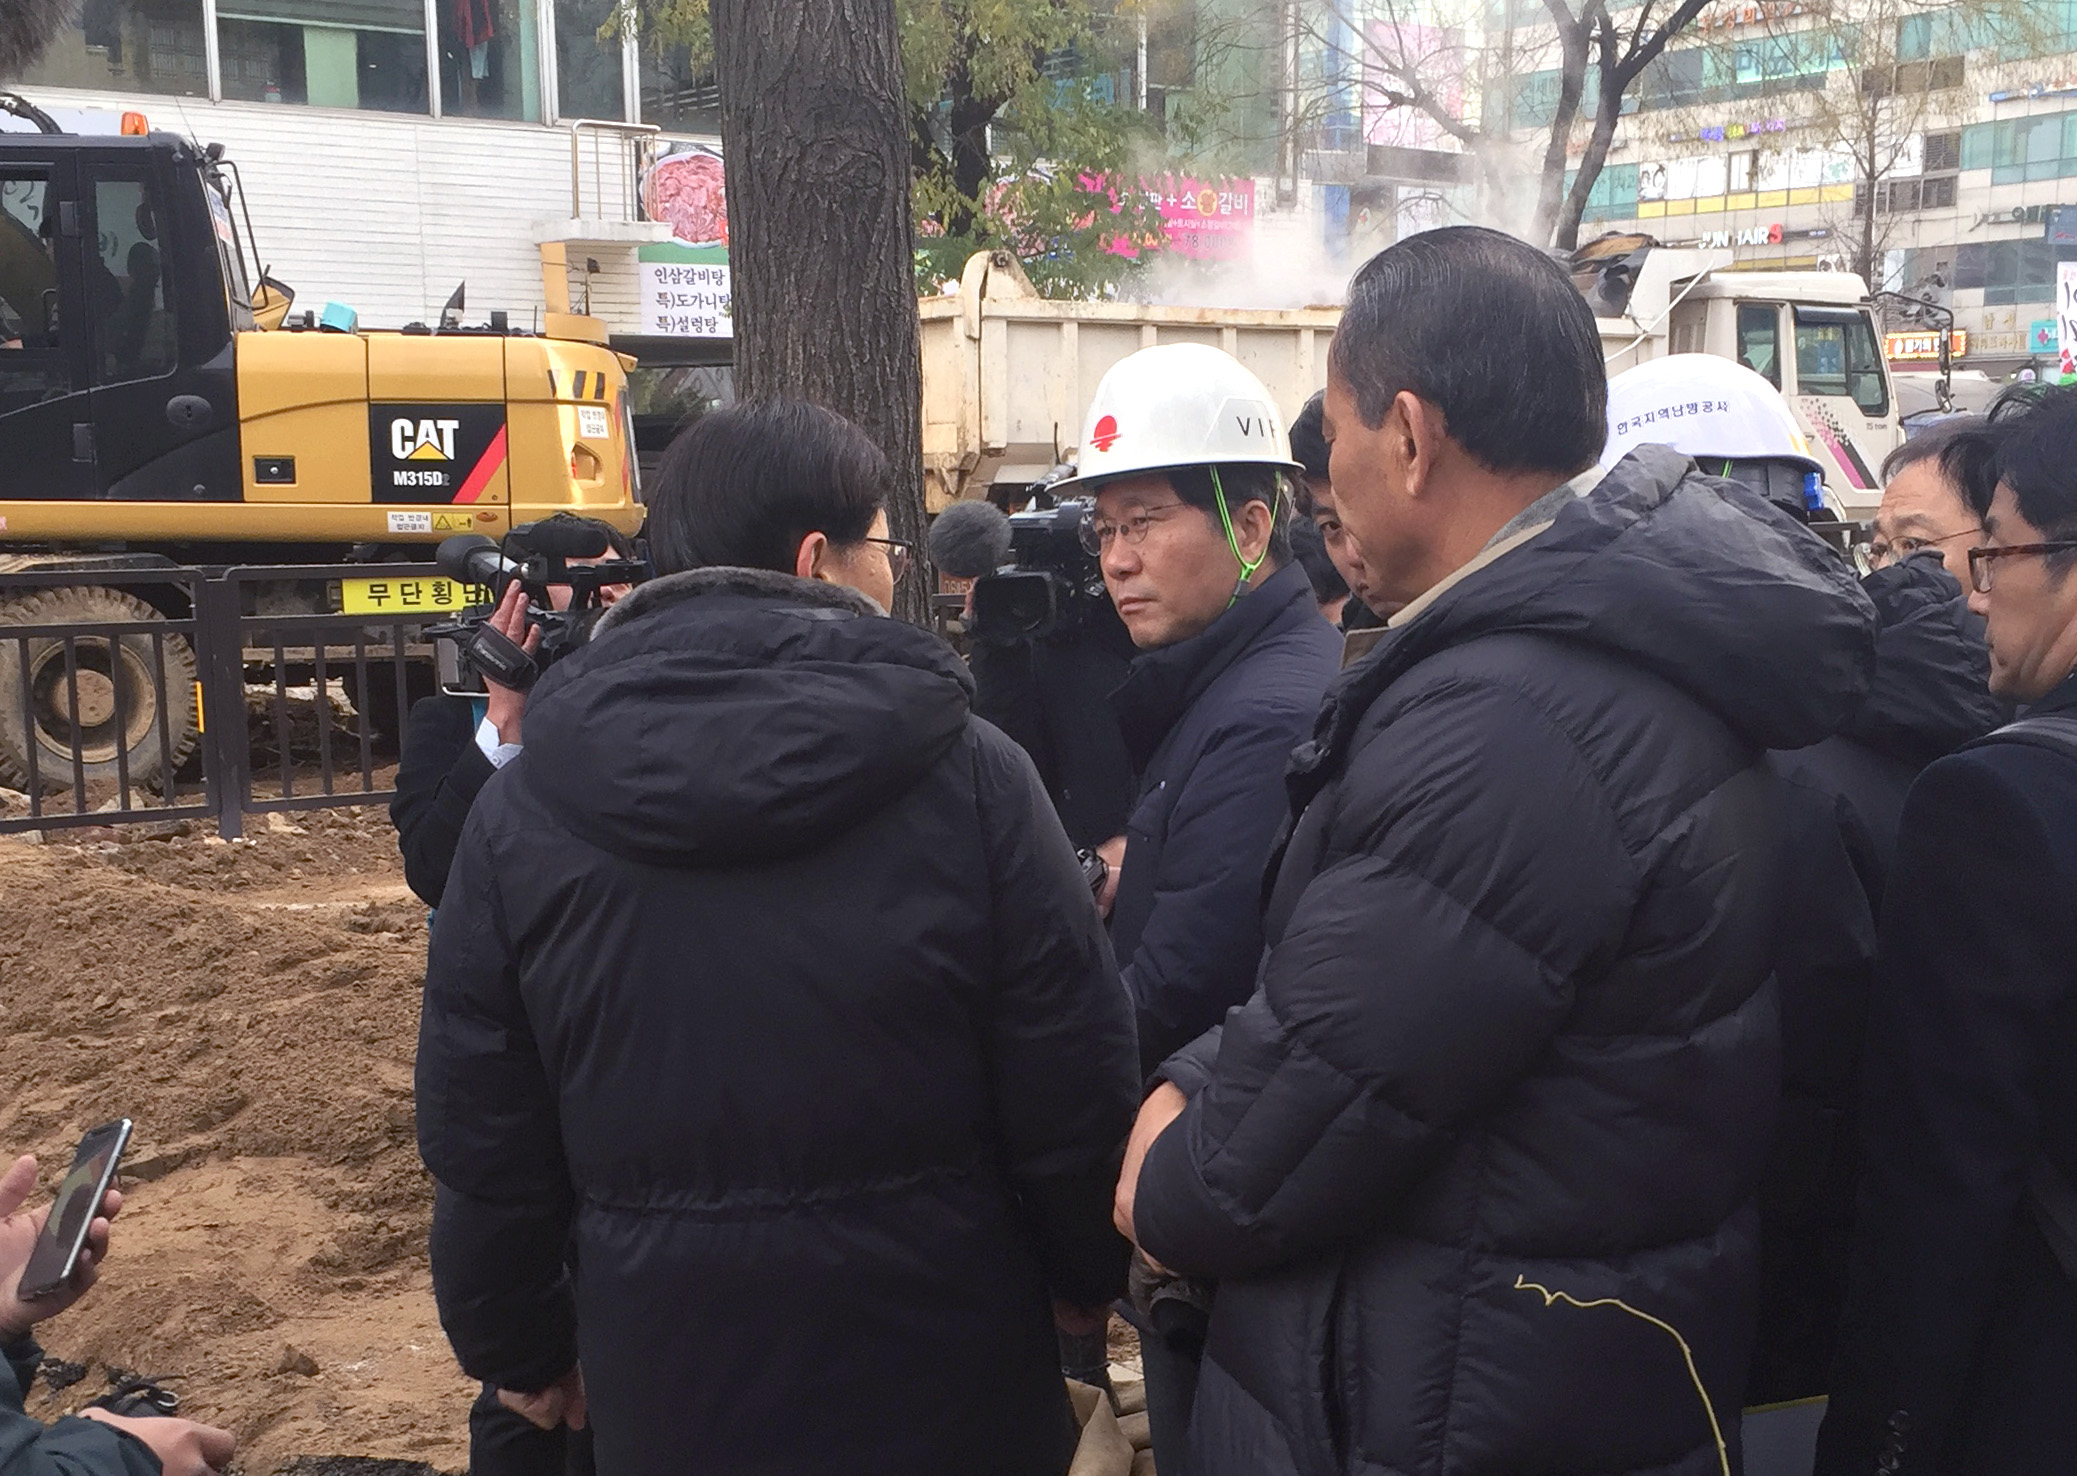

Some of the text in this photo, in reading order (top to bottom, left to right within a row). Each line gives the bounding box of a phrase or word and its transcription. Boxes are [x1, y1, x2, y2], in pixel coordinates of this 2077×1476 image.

[654, 266, 726, 286] 인삼갈비탕
[656, 314, 719, 334] 특)설렁탕
[1617, 400, 1729, 435] 한국지역난방공사
[391, 418, 460, 461] CAT
